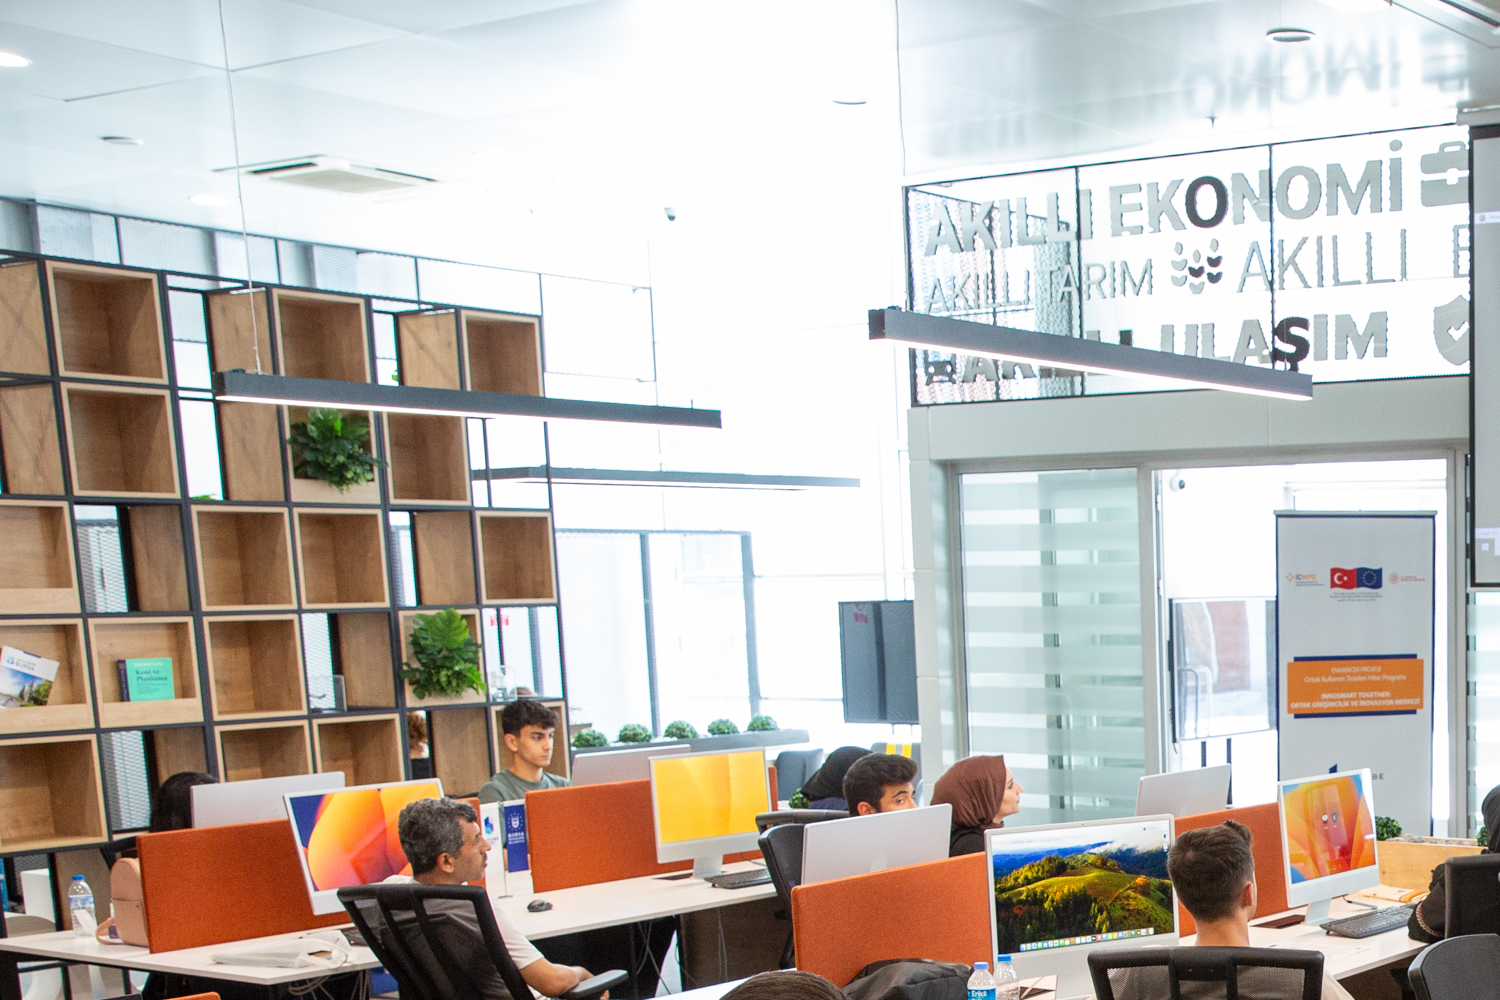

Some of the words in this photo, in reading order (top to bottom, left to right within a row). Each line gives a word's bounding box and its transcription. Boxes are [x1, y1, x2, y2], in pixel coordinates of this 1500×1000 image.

[925, 188, 1093, 256] AKILLI
[1109, 139, 1404, 238] EKONOMİ
[926, 269, 1031, 314] AKILLI
[1048, 258, 1154, 302] TARIM
[1237, 228, 1407, 293] AKILLI
